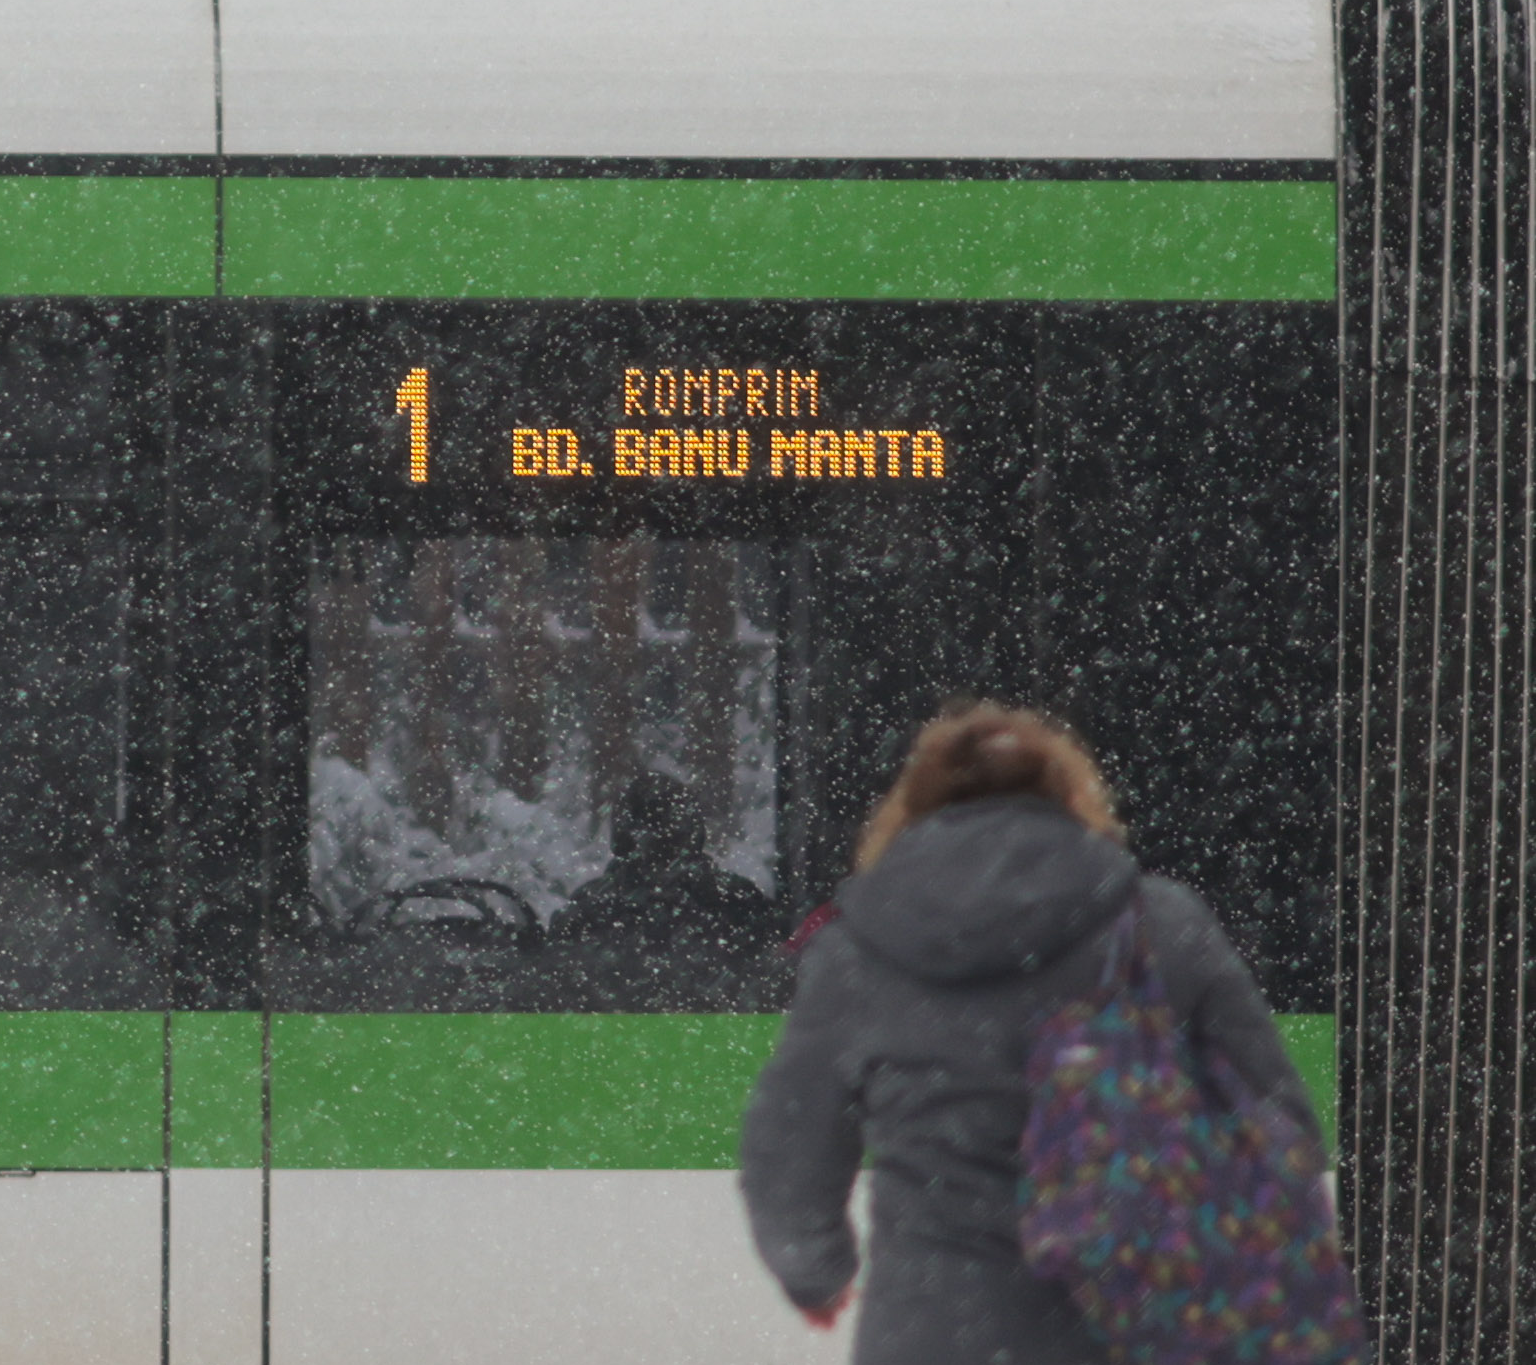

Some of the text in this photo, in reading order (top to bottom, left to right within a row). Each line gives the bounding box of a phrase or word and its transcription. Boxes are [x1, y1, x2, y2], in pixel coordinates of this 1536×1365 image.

[623, 368, 818, 417] ROMPRIM
[395, 367, 428, 483] 1
[511, 428, 946, 478] BD. BANU MANTA
